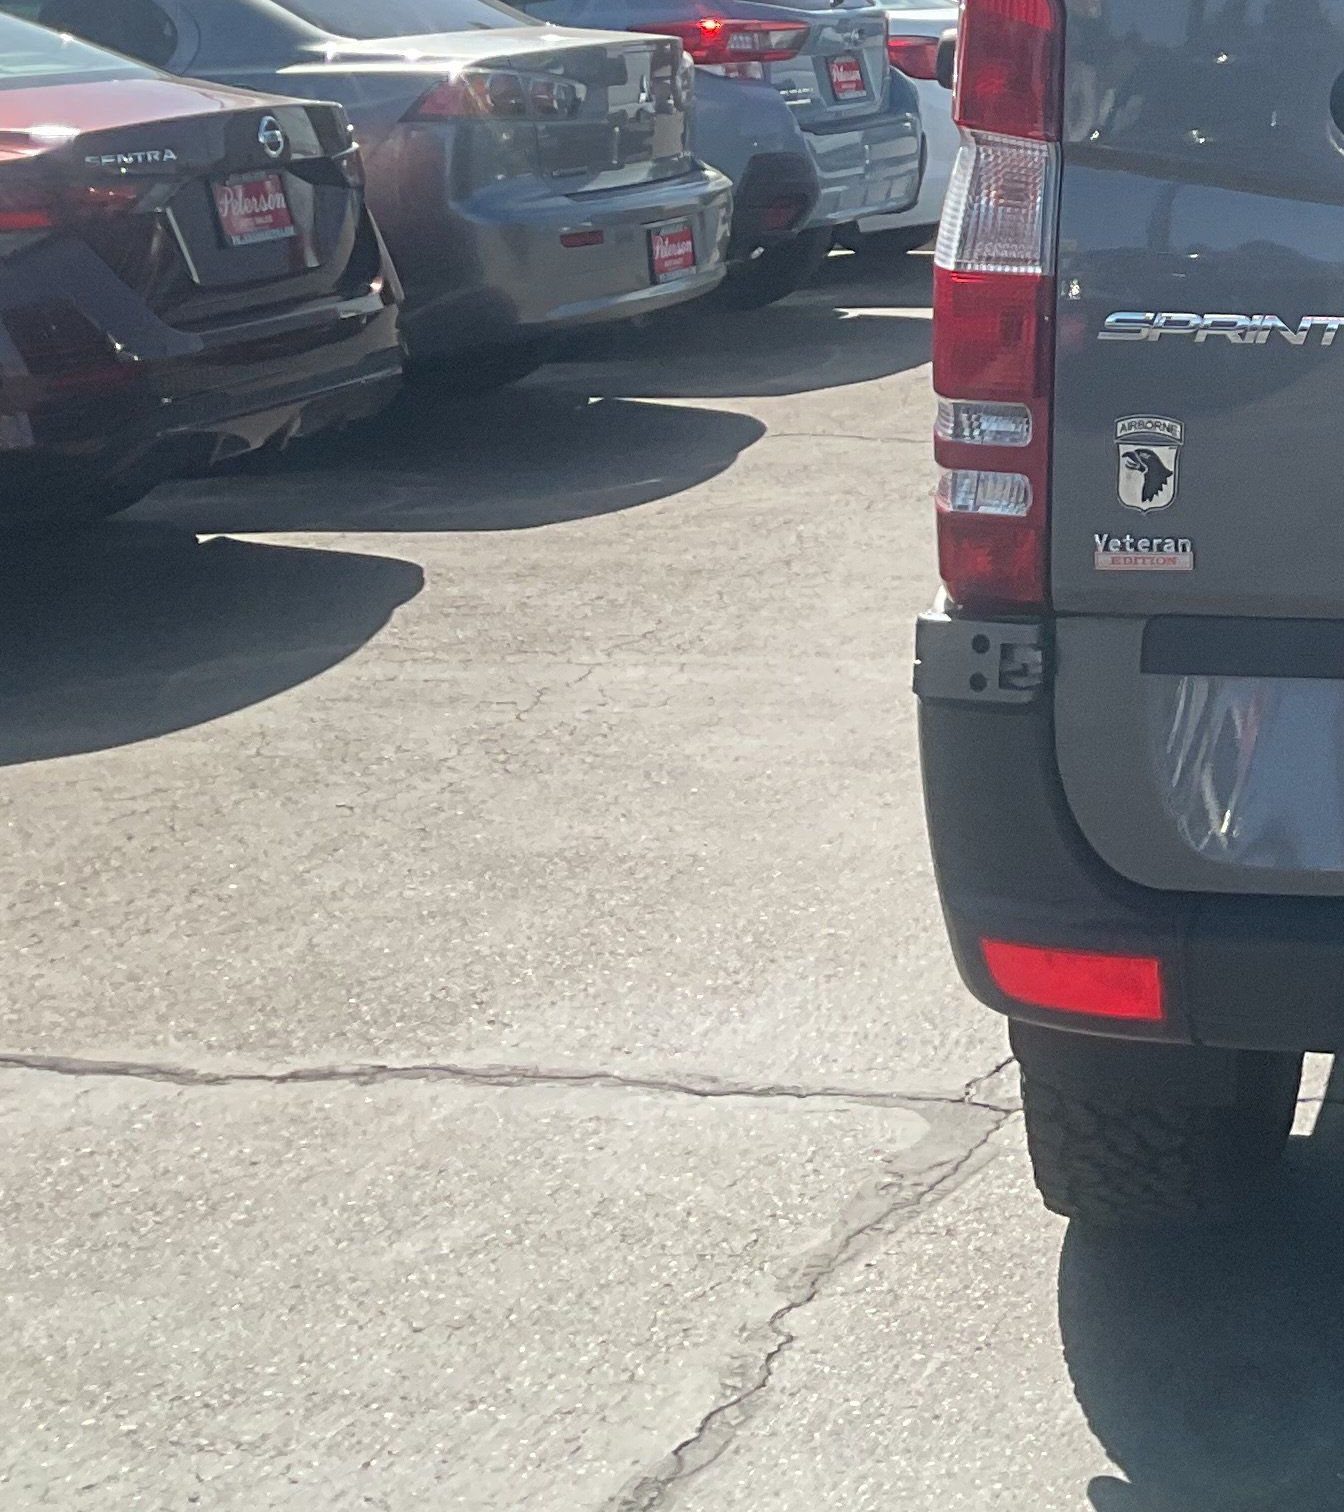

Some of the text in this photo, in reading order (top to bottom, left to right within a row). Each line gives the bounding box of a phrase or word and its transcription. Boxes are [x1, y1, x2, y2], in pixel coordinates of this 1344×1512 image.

[84, 148, 178, 165] SENTRA
[217, 185, 287, 217] Peterson
[1119, 418, 1179, 437] AIRBORNE
[1094, 533, 1191, 554] Veteran
[1111, 556, 1178, 566] EDITION
